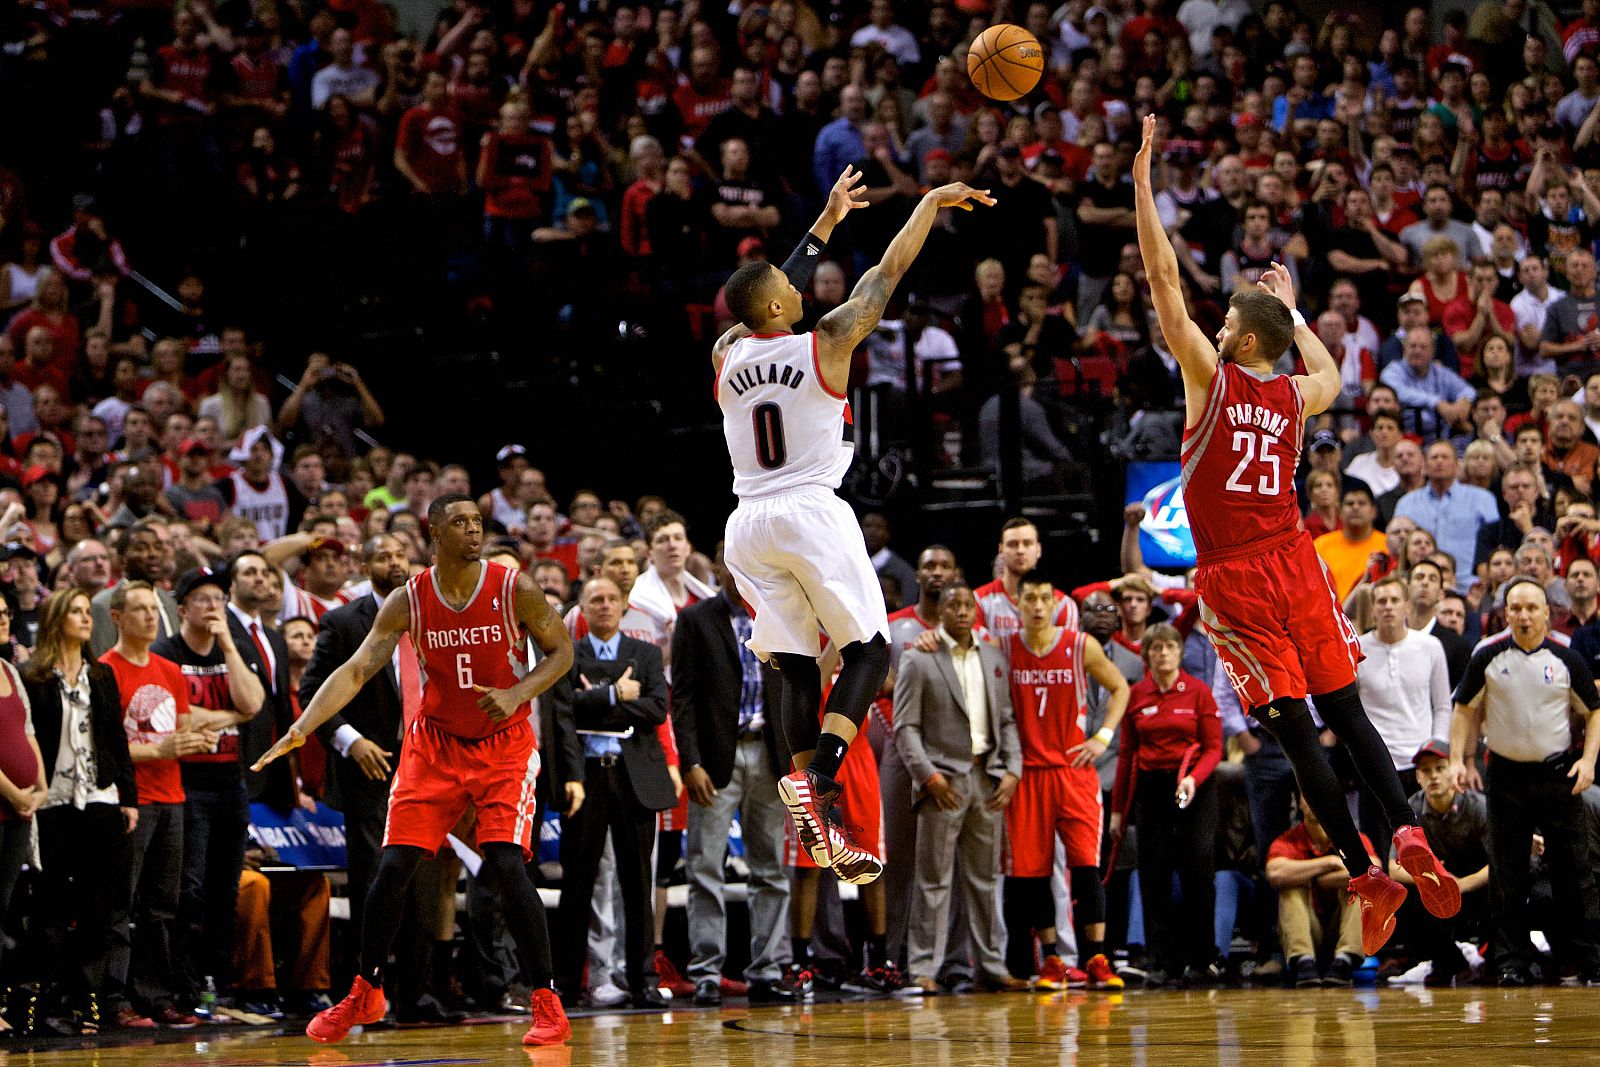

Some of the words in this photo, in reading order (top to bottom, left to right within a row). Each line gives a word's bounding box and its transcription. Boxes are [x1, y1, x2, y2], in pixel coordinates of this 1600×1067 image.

[728, 363, 805, 396] LILLARD
[752, 401, 787, 470] 0
[1226, 403, 1289, 437] PARSONS
[1225, 430, 1280, 496] 25
[425, 624, 502, 650] ROCKETS
[456, 653, 473, 689] 6
[1012, 668, 1073, 685] ROCKETS
[1034, 686, 1048, 717] 7
